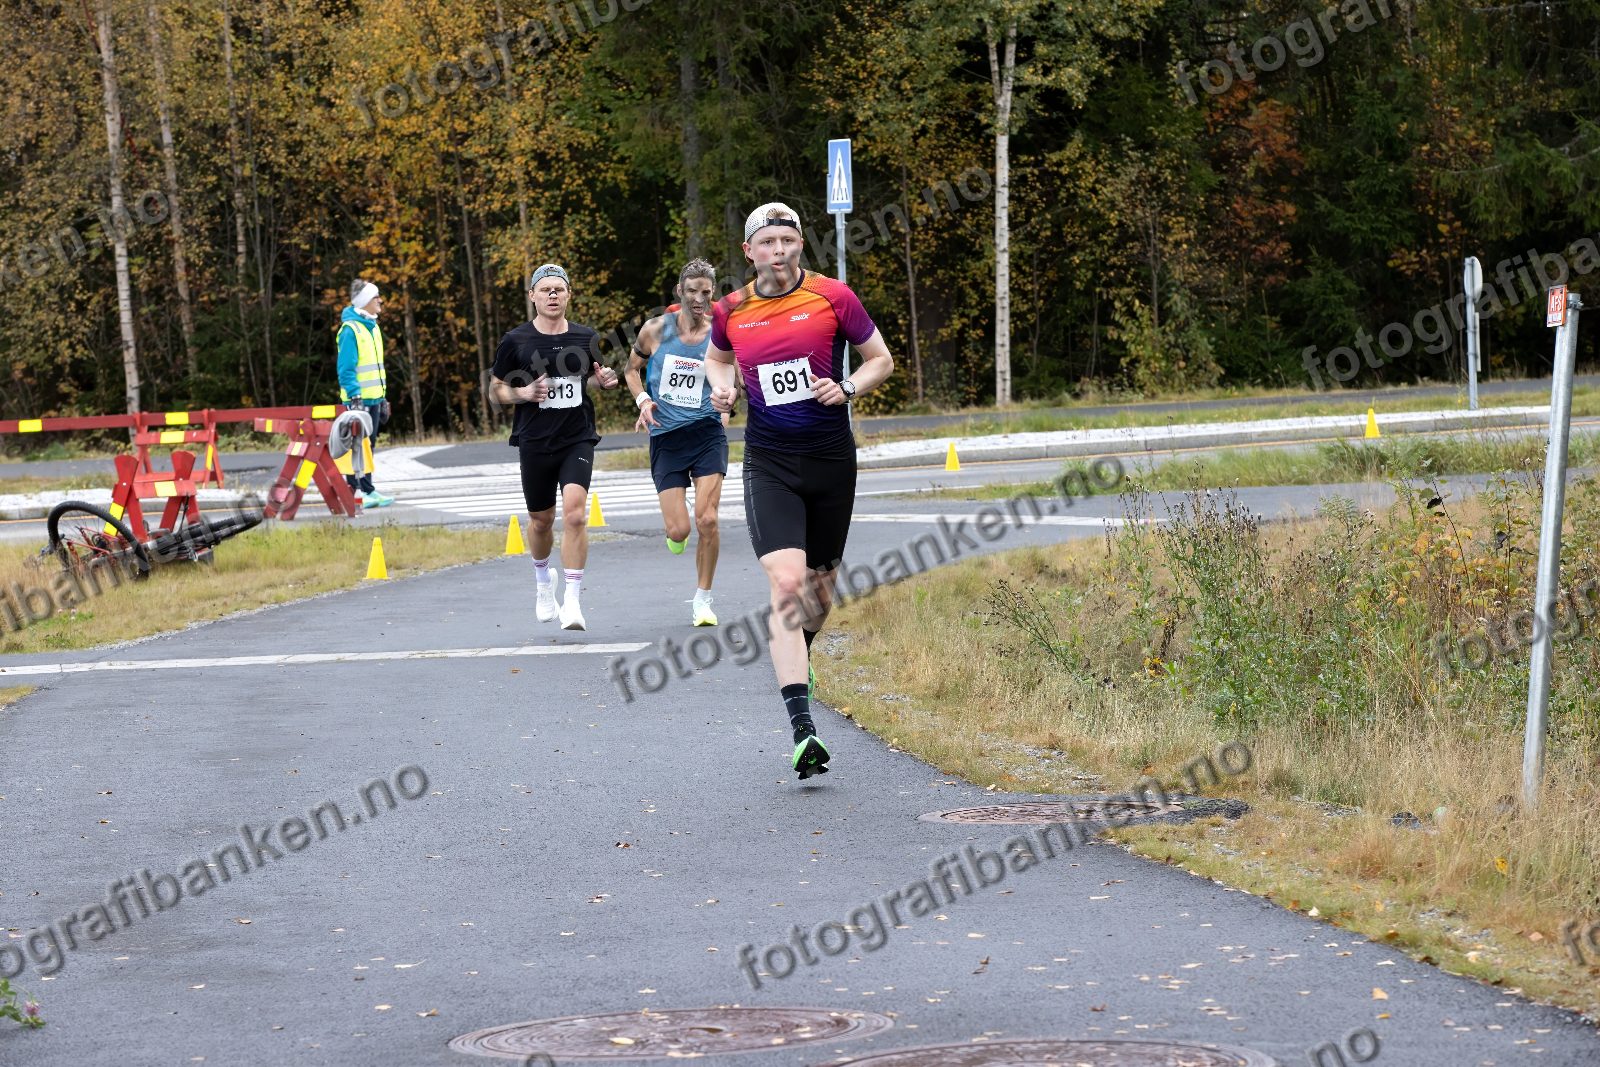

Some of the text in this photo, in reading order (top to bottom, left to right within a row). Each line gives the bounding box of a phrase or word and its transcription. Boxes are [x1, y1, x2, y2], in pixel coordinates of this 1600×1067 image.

[669, 373, 696, 389] 870
[772, 367, 810, 395] 691
[547, 383, 574, 399] 813
